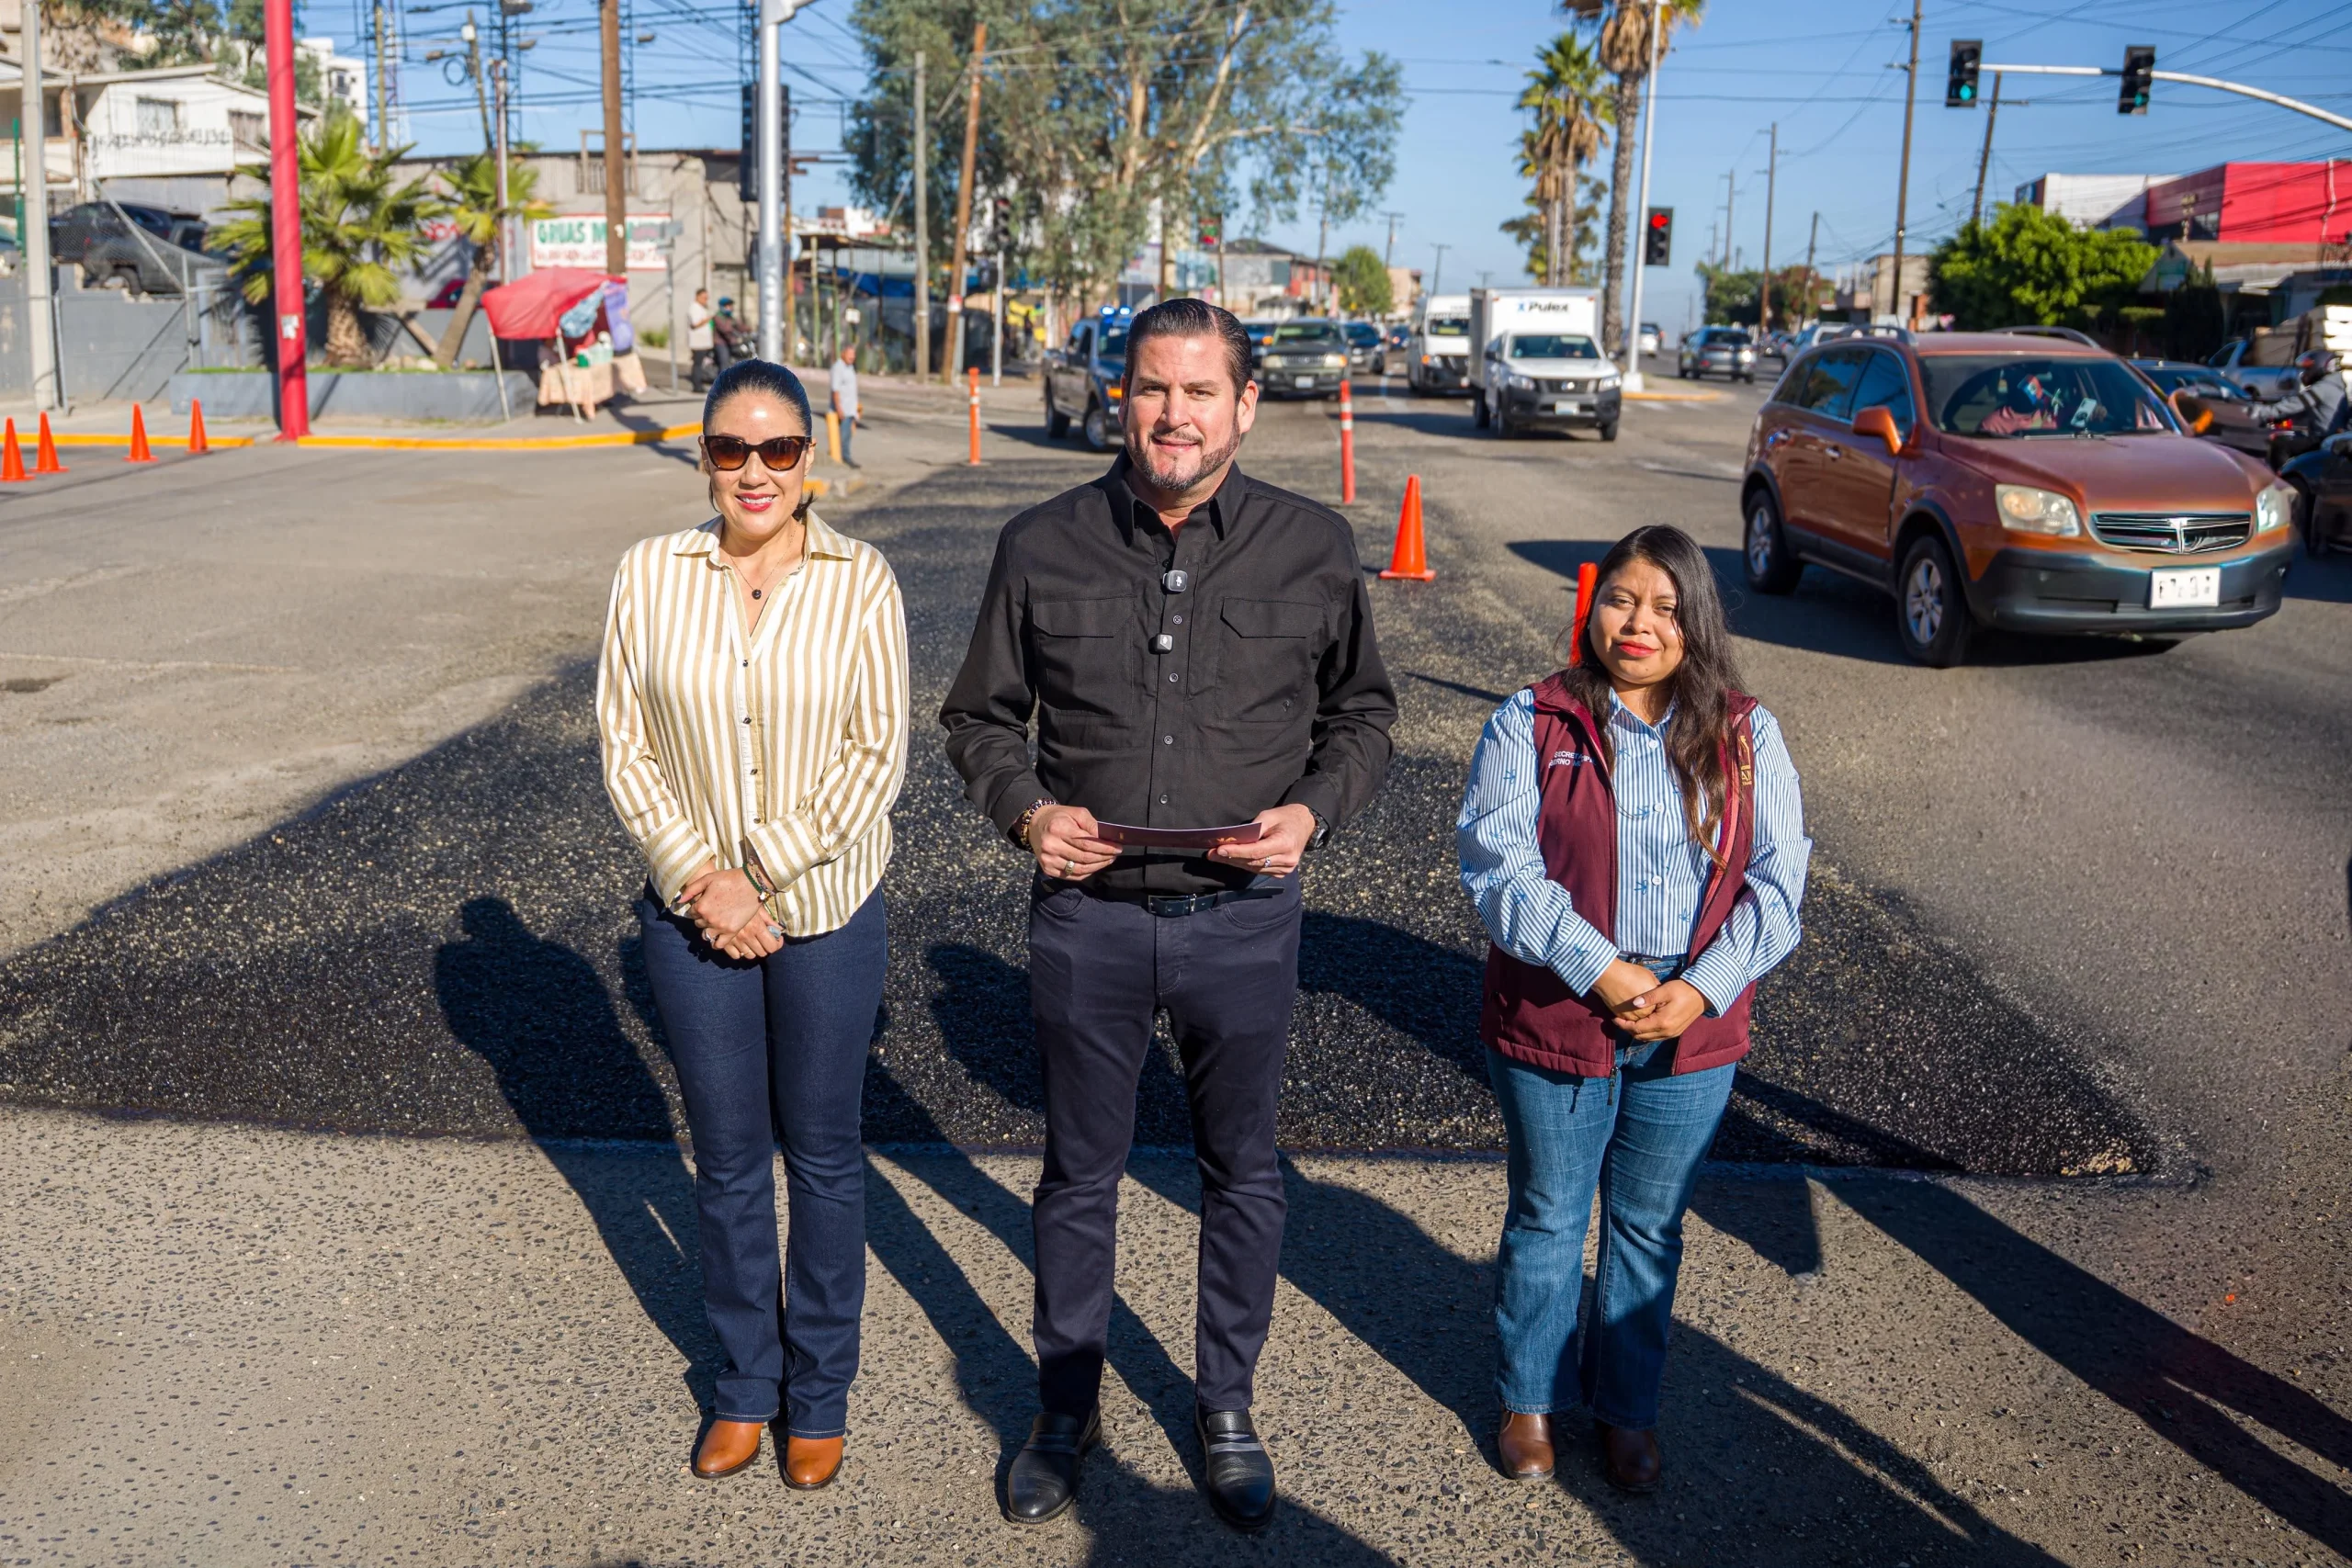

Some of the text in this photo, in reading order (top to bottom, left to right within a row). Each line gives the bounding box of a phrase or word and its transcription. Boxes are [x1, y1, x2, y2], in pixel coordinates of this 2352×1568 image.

[537, 221, 585, 243] GRUAS
[1528, 301, 1569, 313] Pulex
[1554, 750, 1583, 759] SECRETA
